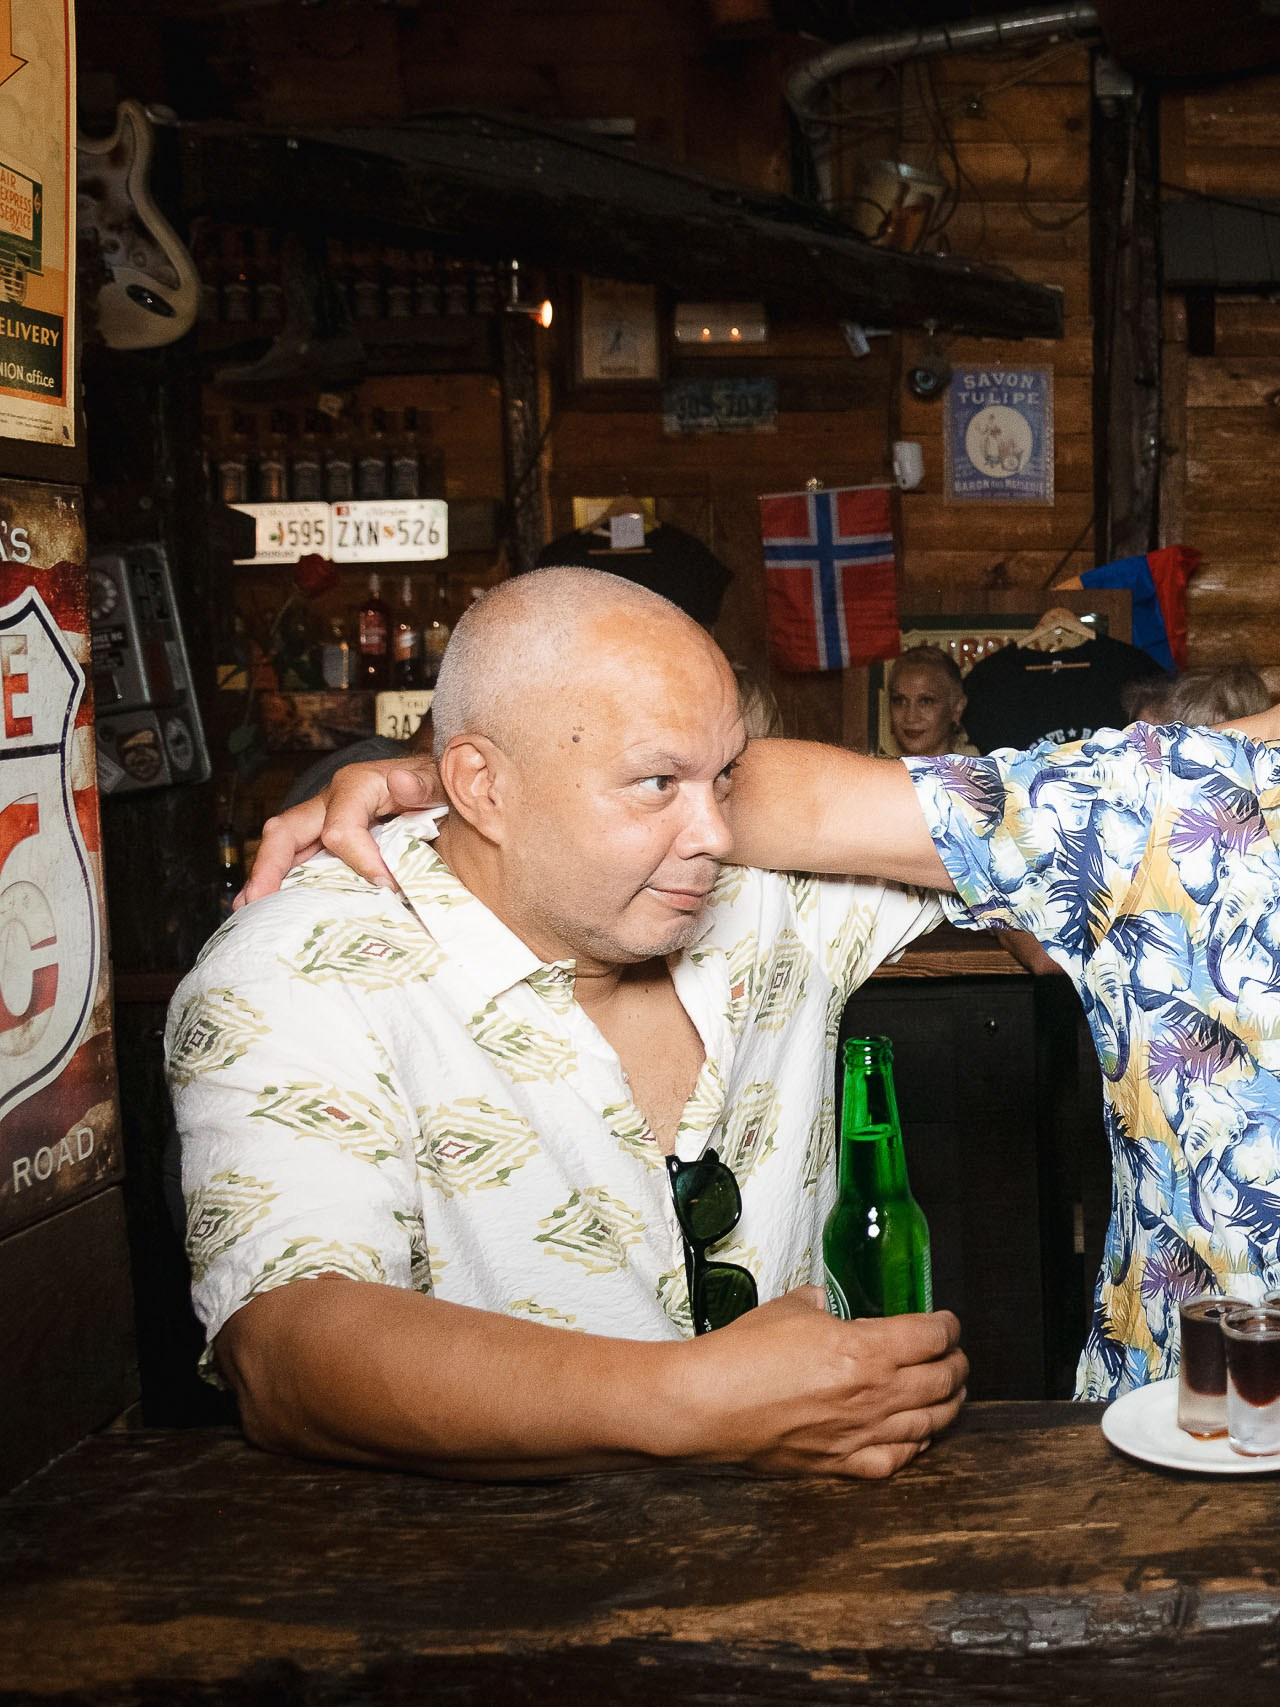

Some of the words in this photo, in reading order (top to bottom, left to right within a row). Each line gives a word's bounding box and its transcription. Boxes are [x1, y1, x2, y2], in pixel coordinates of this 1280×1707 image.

[26, 369, 55, 388] office
[962, 372, 1035, 390] SAVON
[957, 391, 1041, 405] TULIPE
[337, 520, 380, 548] ZXN
[396, 519, 440, 546] 526
[12, 1126, 95, 1194] ROAD
